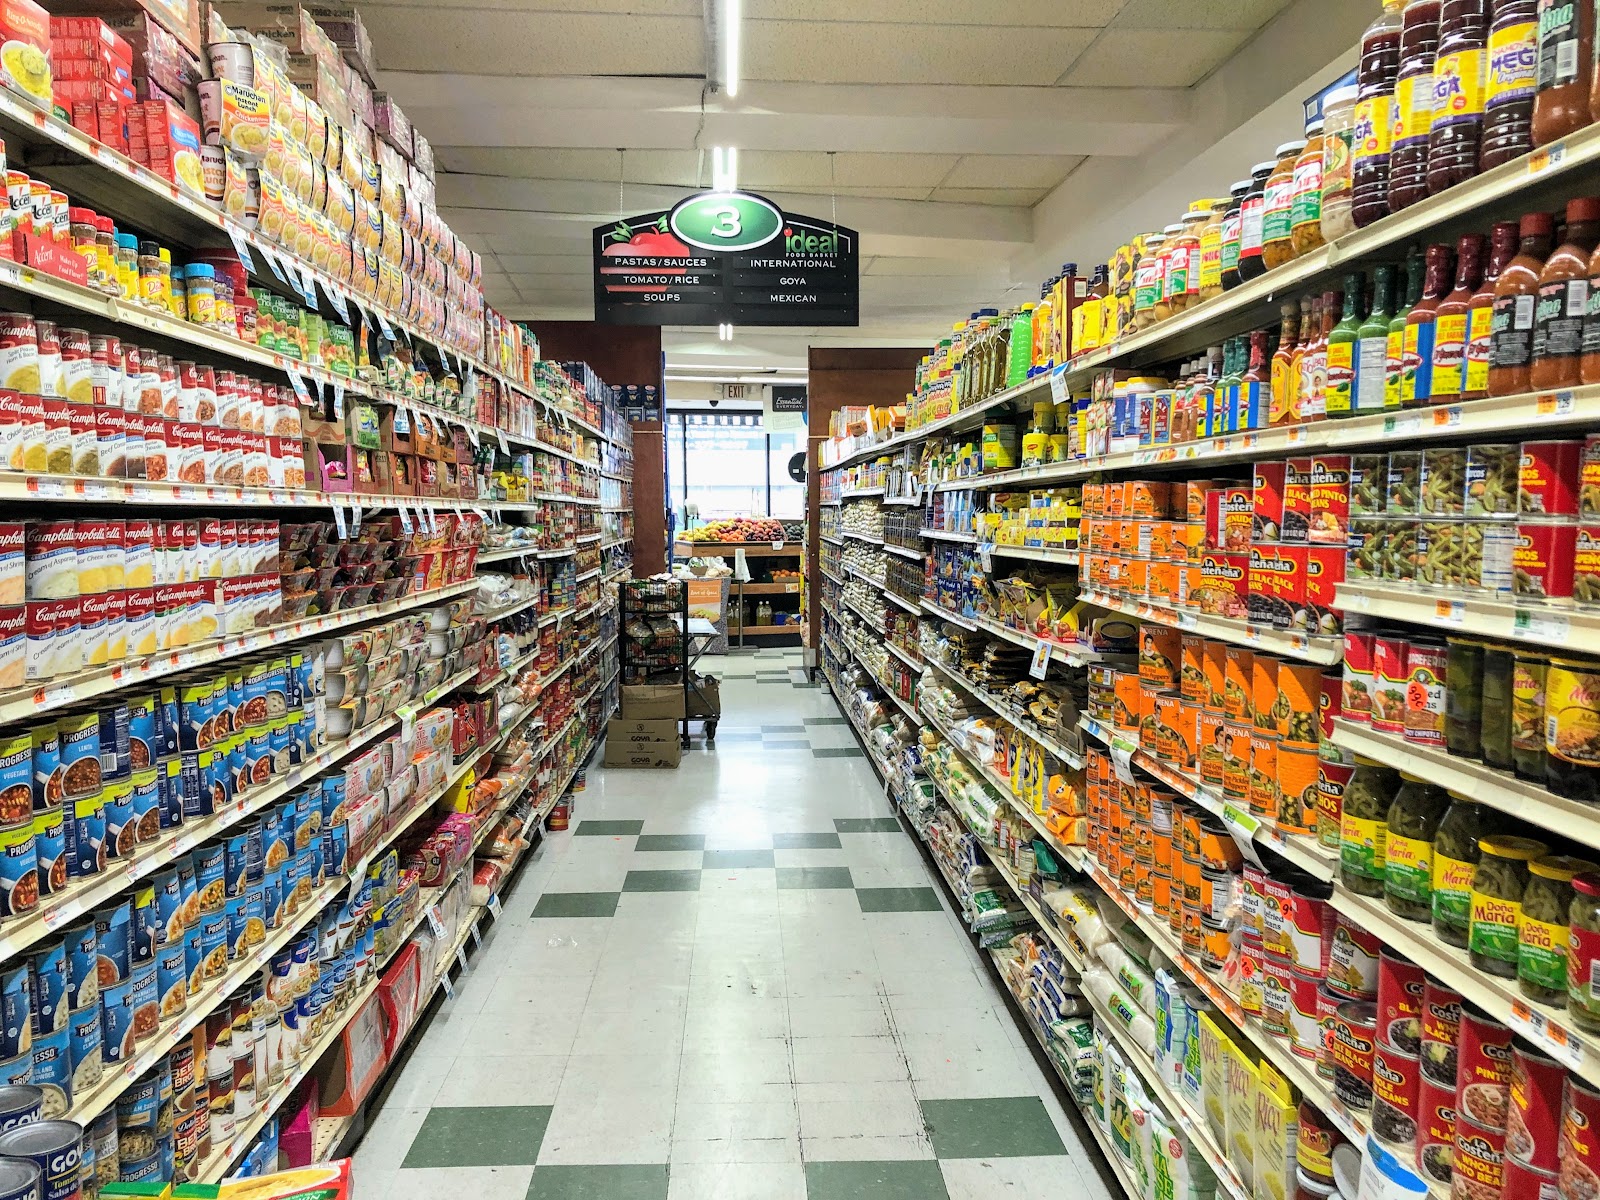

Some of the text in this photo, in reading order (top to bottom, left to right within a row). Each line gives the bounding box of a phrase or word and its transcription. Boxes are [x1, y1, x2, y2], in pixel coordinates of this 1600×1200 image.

[231, 85, 266, 104] Maruchan
[234, 95, 259, 108] Instant
[237, 102, 257, 113] Lunch
[235, 110, 256, 123] Chicken
[710, 205, 742, 238] 3
[784, 228, 838, 253] ideal
[34, 246, 53, 265] Accent
[59, 254, 79, 269] Makes Up
[614, 257, 707, 268] PASTAS/SAUCES
[750, 259, 836, 269] INTERNATIONAL
[58, 264, 69, 275] Food
[623, 275, 700, 285] TOMATO/RICE
[779, 277, 807, 286] GOYA
[643, 293, 681, 302] SOUPS
[770, 294, 817, 303] MEXICAN
[728, 385, 745, 399] EXIT
[776, 396, 803, 405] Essential
[100, 444, 114, 456] Beef
[1315, 465, 1324, 473] La
[1233, 495, 1244, 503] La
[1322, 489, 1348, 504] PINTO
[31, 553, 48, 561] GREAT
[28, 564, 48, 580] Cream
[1413, 730, 1441, 739] CHIPOTLE
[1486, 901, 1515, 914] Doña
[1474, 906, 1515, 924] María
[1476, 923, 1515, 935] Nopalitos
[1526, 921, 1550, 935] Doña
[1424, 1023, 1452, 1043] BLACK
[1334, 1051, 1355, 1069] BEANS
[1344, 1049, 1371, 1071] BLACK
[1378, 1088, 1409, 1107] BEANS
[1473, 1137, 1488, 1150] La
[121, 1161, 158, 1182] PROGRESSO
[1461, 1154, 1501, 1176] WHOLE
[48, 1186, 70, 1200] Salsa
